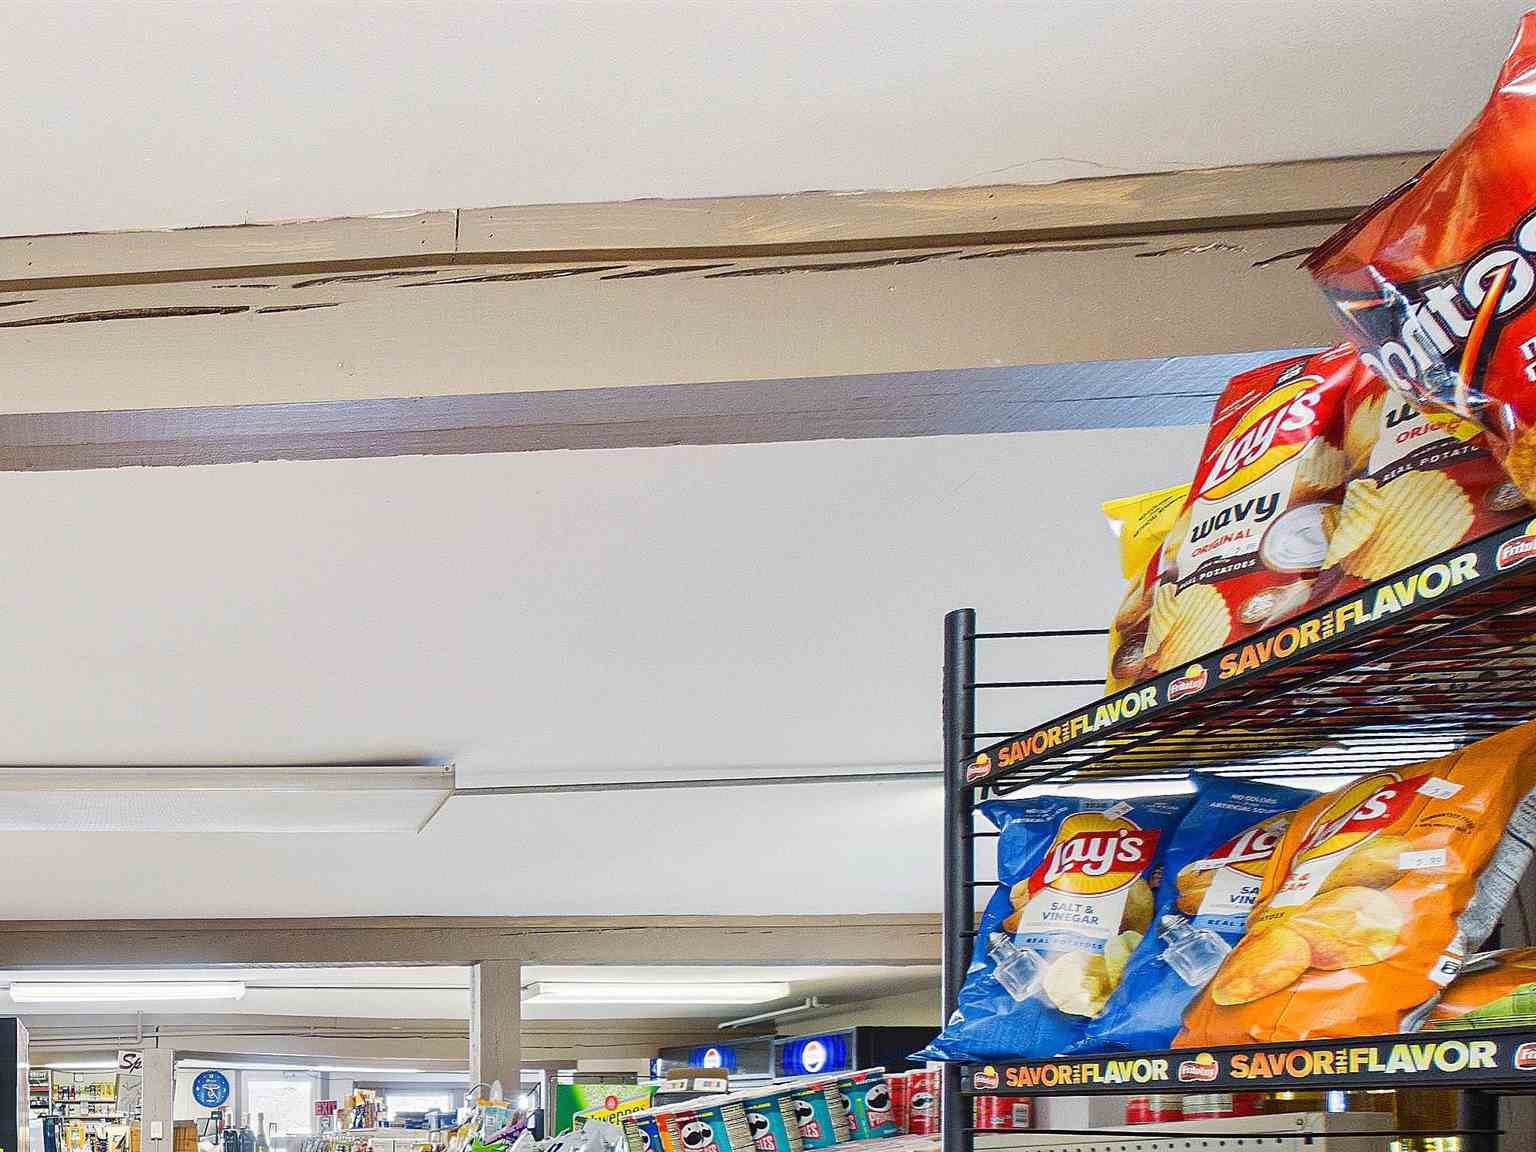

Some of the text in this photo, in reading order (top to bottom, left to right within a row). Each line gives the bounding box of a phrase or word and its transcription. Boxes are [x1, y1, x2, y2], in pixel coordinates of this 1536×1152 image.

[1200, 388, 1323, 497] Lay's
[1420, 444, 1480, 469] POTATO
[1191, 491, 1281, 544] wavy
[1192, 528, 1253, 558] ORIGINAL
[1200, 558, 1257, 583] POTATOES
[1219, 618, 1323, 682] SAVOR
[1336, 552, 1480, 634] FLAVOR
[998, 725, 1062, 768] SAVOR
[1070, 686, 1159, 738] FLAVOR
[1045, 829, 1144, 884] Lay's
[1041, 911, 1099, 925] VINEGAR
[1051, 902, 1094, 914] SALT &
[1006, 1064, 1073, 1087] SAVOR
[1081, 1059, 1168, 1084] FLAVOR
[1231, 1050, 1334, 1079] SAVOR
[1350, 1040, 1498, 1074] FLAVOR
[315, 1101, 336, 1114] EXIT
[592, 1105, 648, 1124] weppes
